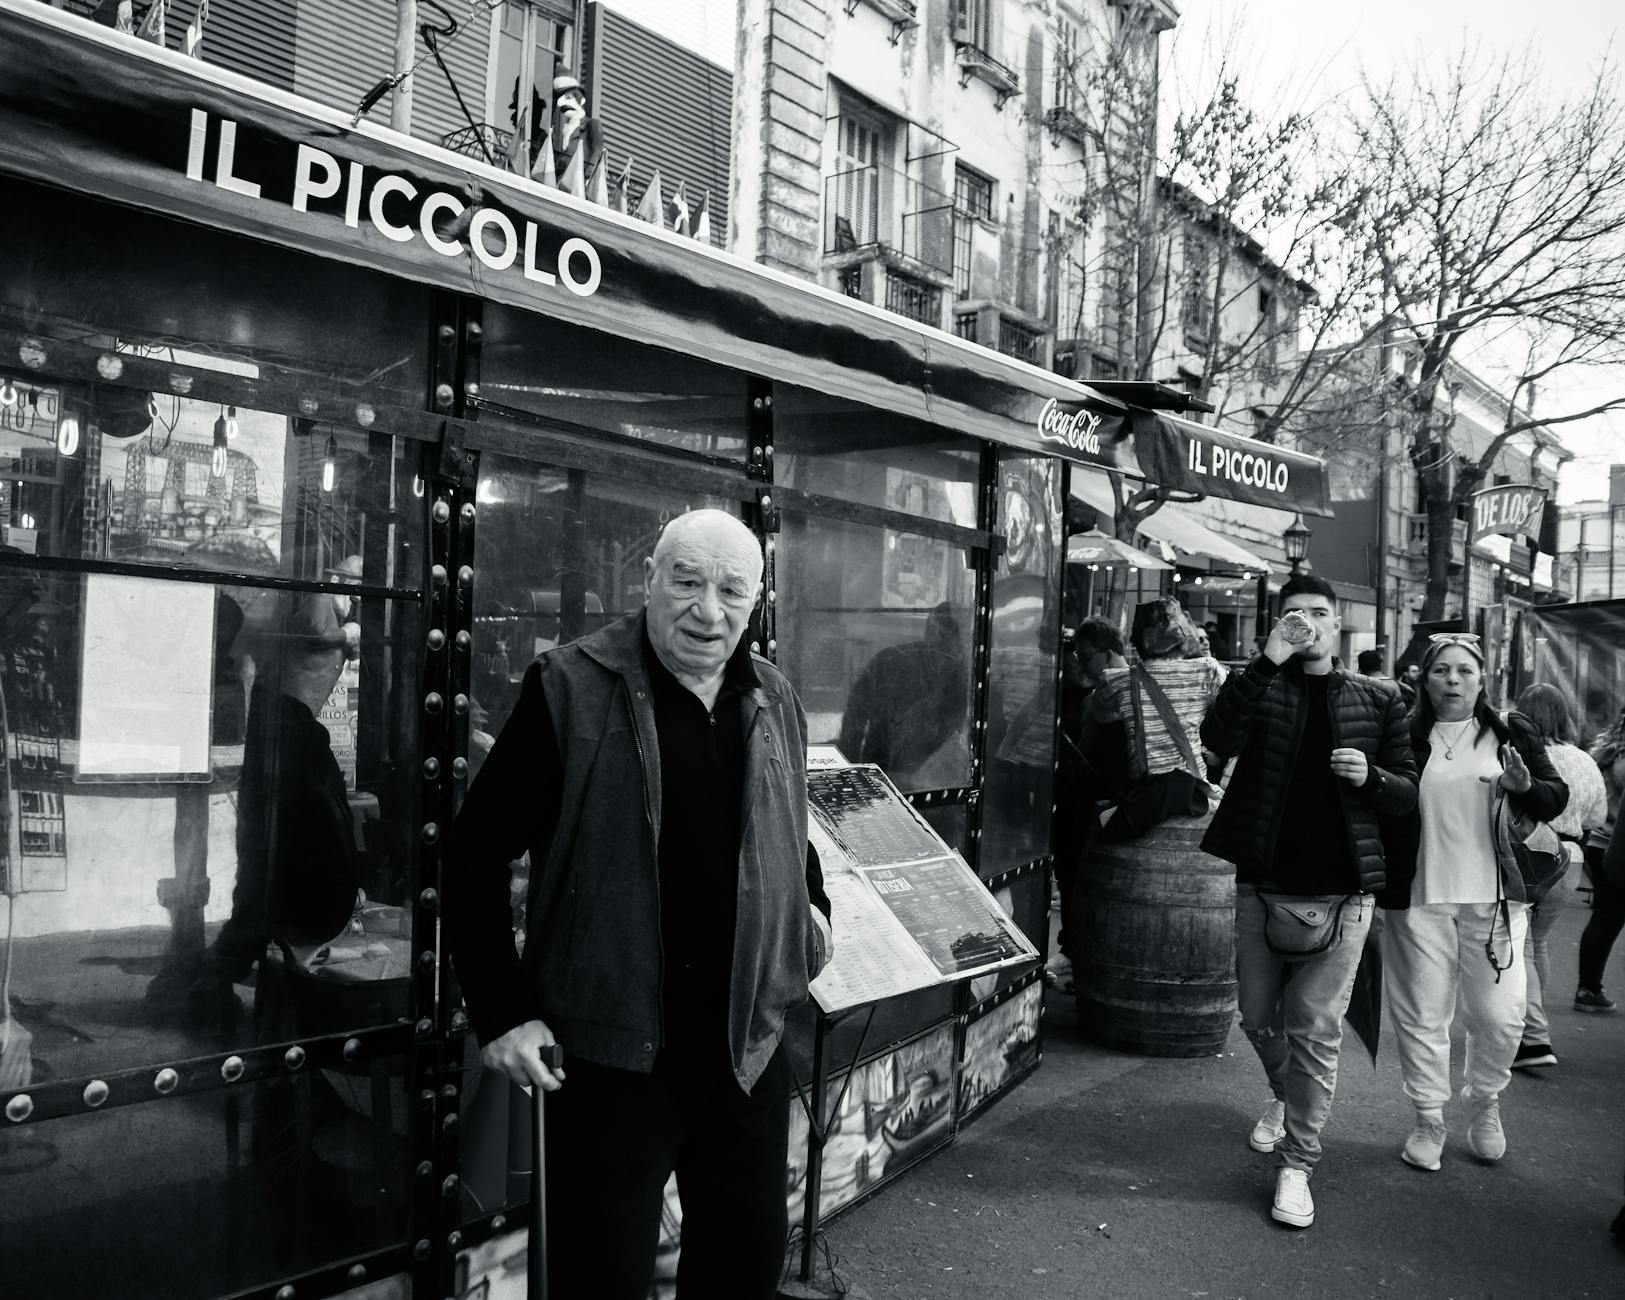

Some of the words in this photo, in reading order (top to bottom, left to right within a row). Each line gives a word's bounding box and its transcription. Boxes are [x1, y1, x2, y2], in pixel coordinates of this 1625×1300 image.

[186, 108, 261, 198] IL
[292, 144, 603, 297] PICCOLO
[1038, 397, 1102, 455] Coca-Cola
[1188, 438, 1207, 474] IL
[1212, 445, 1289, 493] PICCOLO
[1474, 494, 1499, 532] DE
